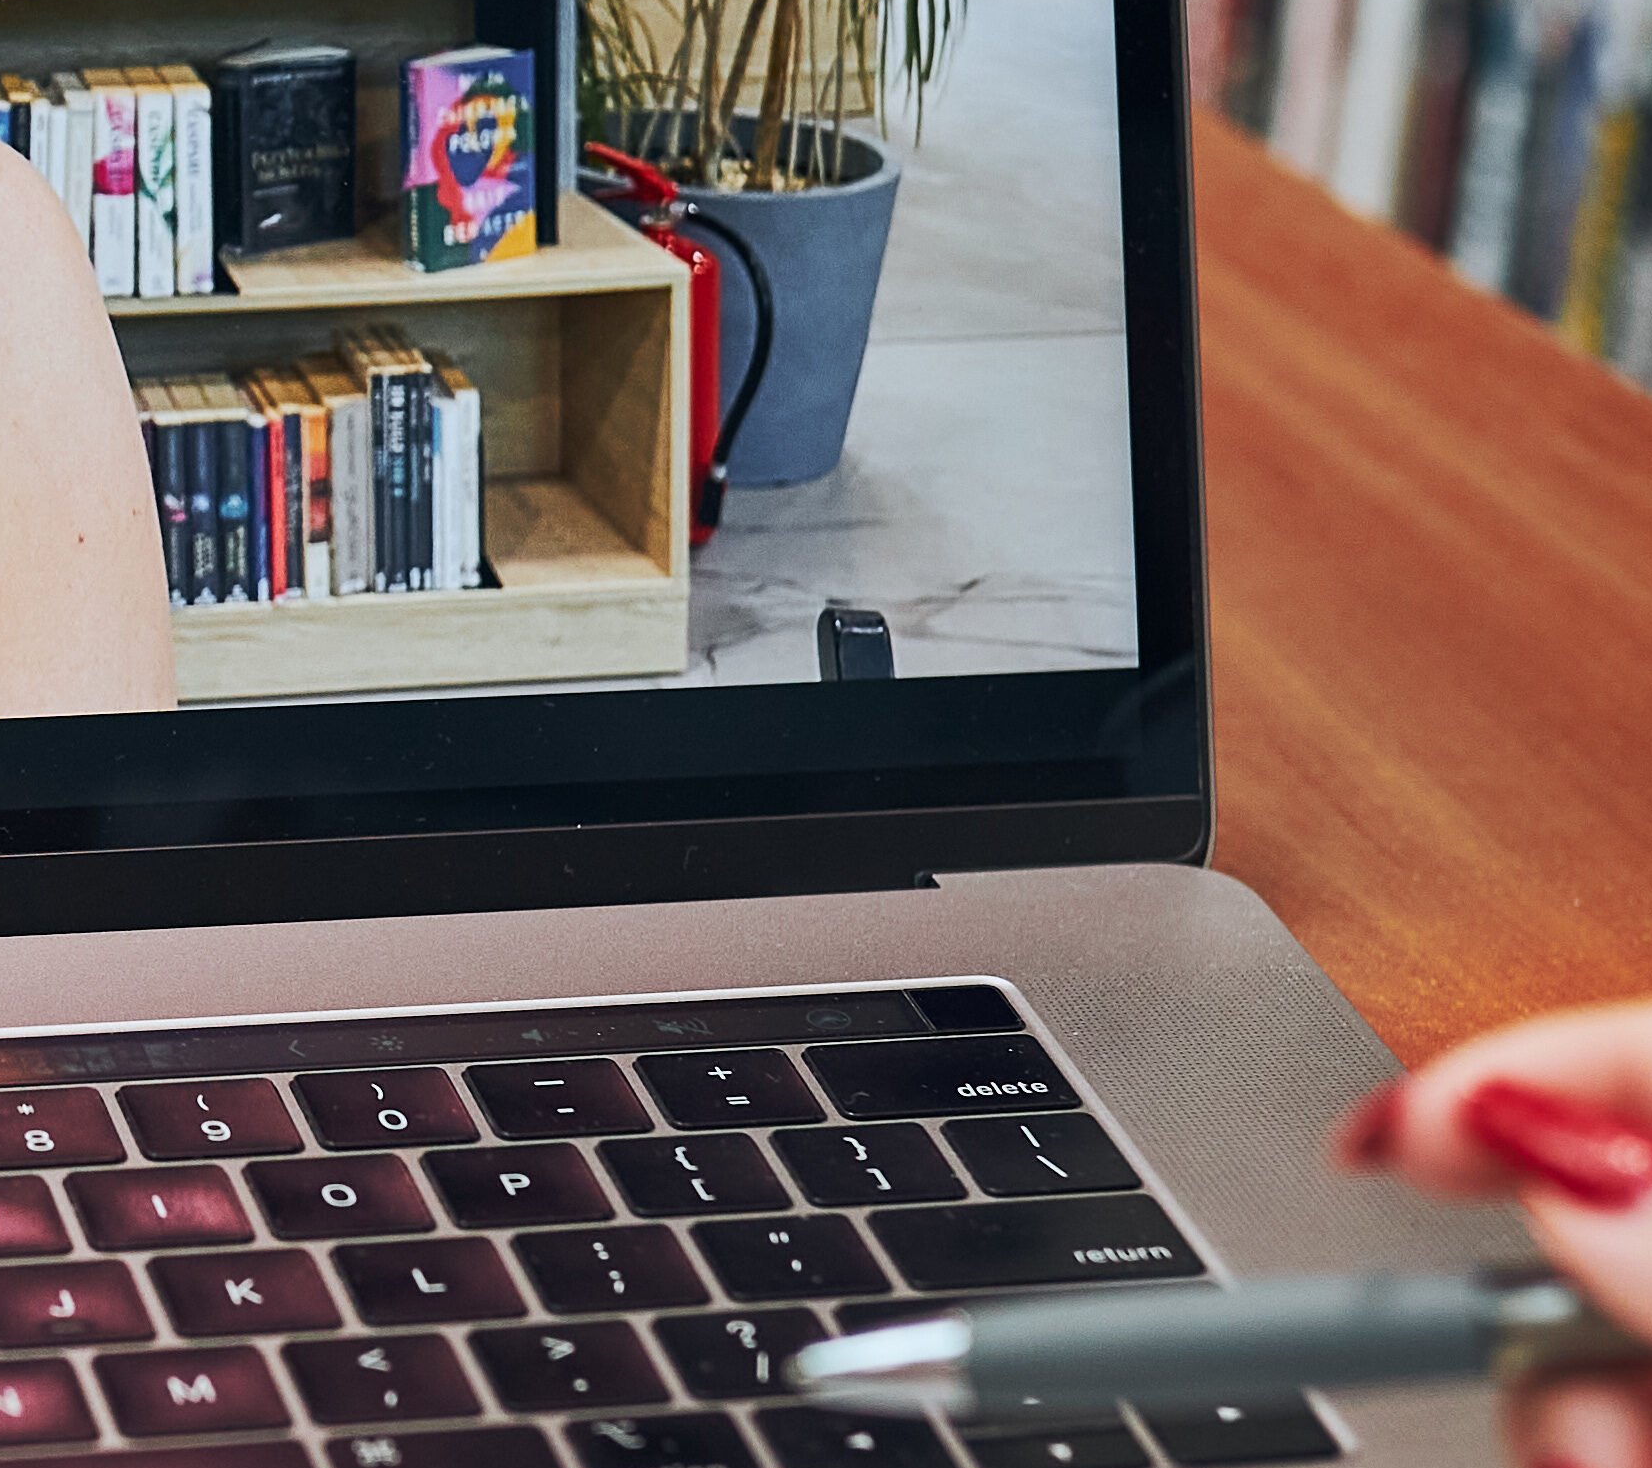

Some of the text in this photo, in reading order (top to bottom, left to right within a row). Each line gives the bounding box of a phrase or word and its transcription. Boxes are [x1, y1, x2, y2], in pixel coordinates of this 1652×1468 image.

[707, 1066, 733, 1080] +
[957, 1076, 1049, 1098] delete
[725, 1095, 751, 1105] =
[200, 1120, 231, 1142] 9
[377, 1109, 408, 1130] 0
[24, 1129, 55, 1152] 8
[321, 1183, 358, 1208] O
[499, 1173, 531, 1196] P
[151, 1194, 168, 1219] I
[1073, 1246, 1172, 1263] return
[224, 1278, 263, 1305] K
[411, 1267, 446, 1294] L
[48, 1289, 76, 1318] J
[166, 1374, 217, 1405] M
